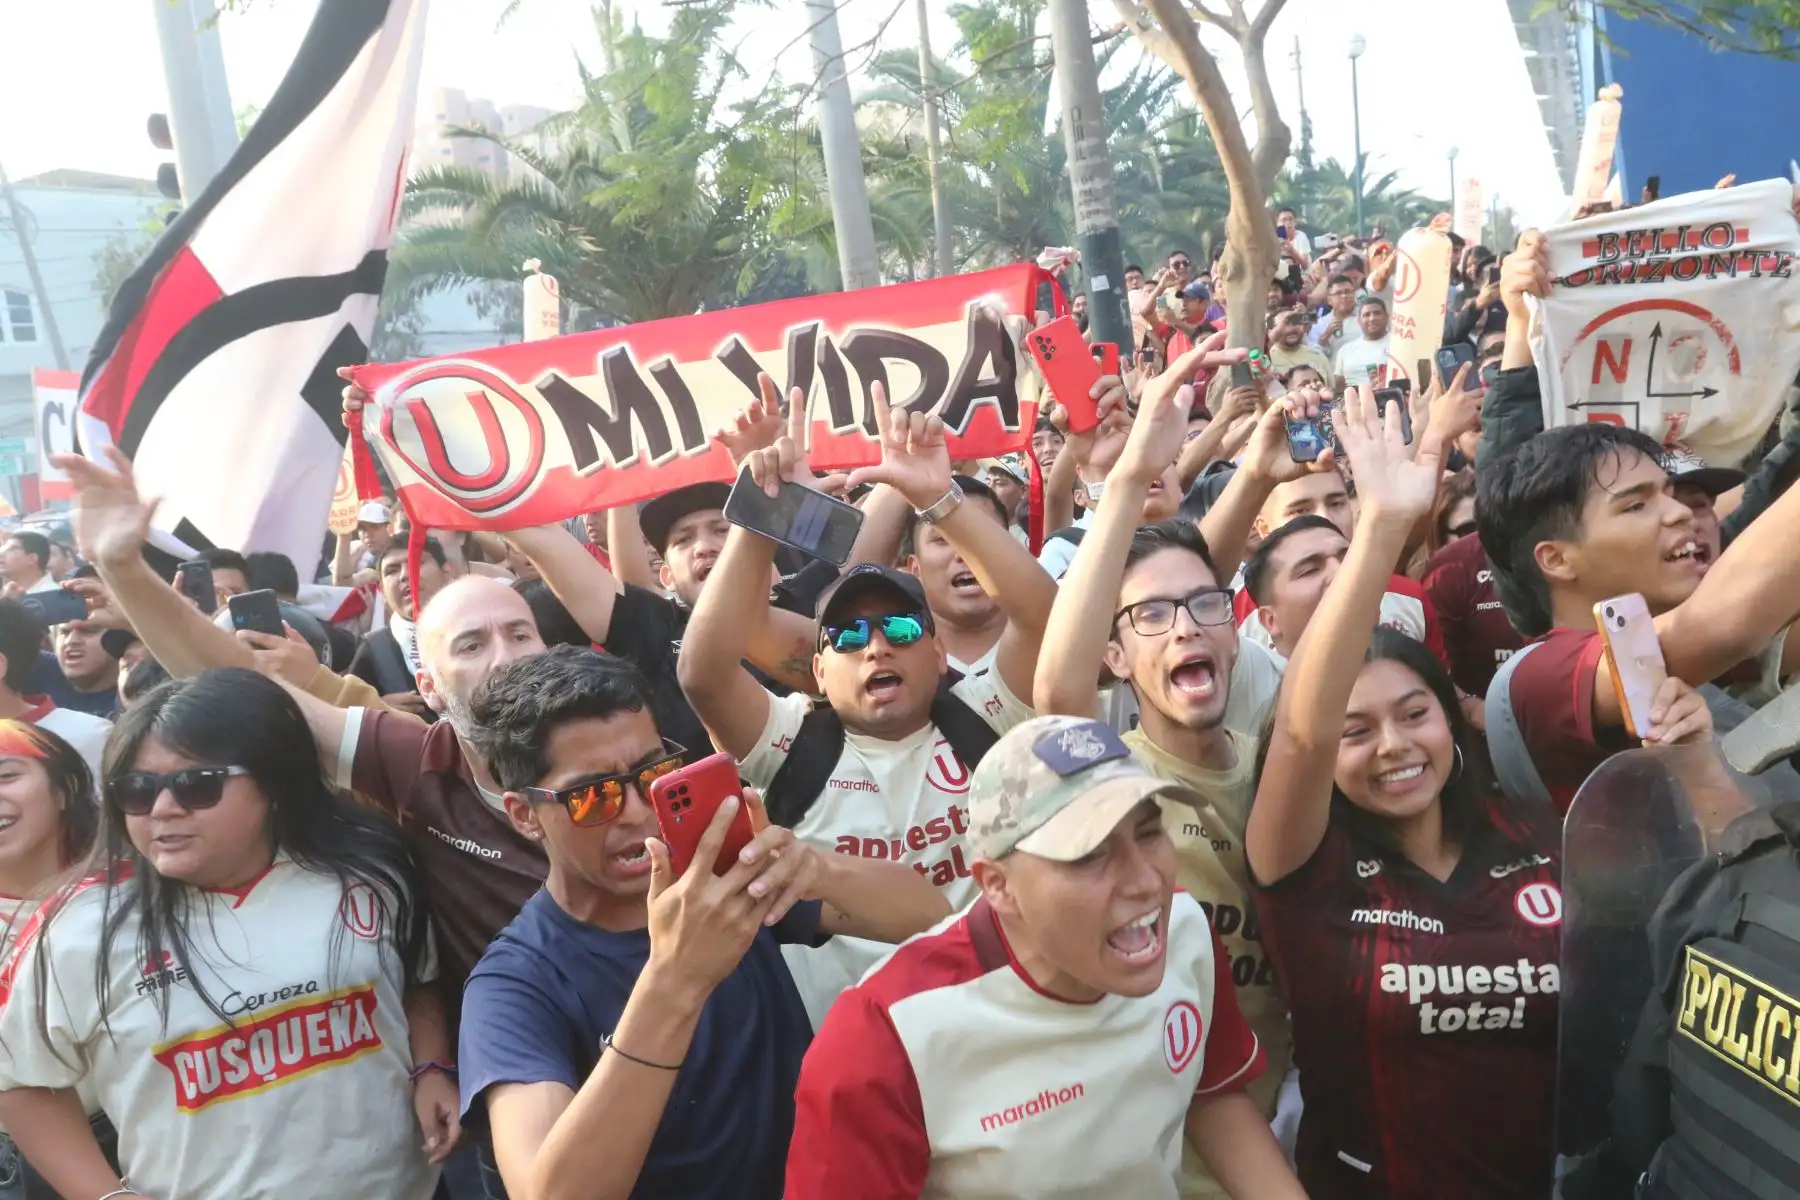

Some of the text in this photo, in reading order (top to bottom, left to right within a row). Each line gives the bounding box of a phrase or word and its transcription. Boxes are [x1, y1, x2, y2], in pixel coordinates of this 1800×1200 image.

[1597, 221, 1736, 264] BELLO
[1555, 250, 1796, 288] ORIZONTE
[535, 345, 710, 476] MI
[716, 299, 1021, 442] VIDA
[829, 779, 880, 793] maratho
[427, 825, 502, 859] marathon
[1351, 908, 1444, 935] marathon
[220, 979, 320, 1017] Cerveza
[1379, 957, 1561, 1005] apuesta
[1418, 996, 1526, 1035] total
[1682, 957, 1800, 1096] POLICI
[173, 995, 375, 1101] CUSQUEÑA
[980, 1082, 1085, 1133] marathon
